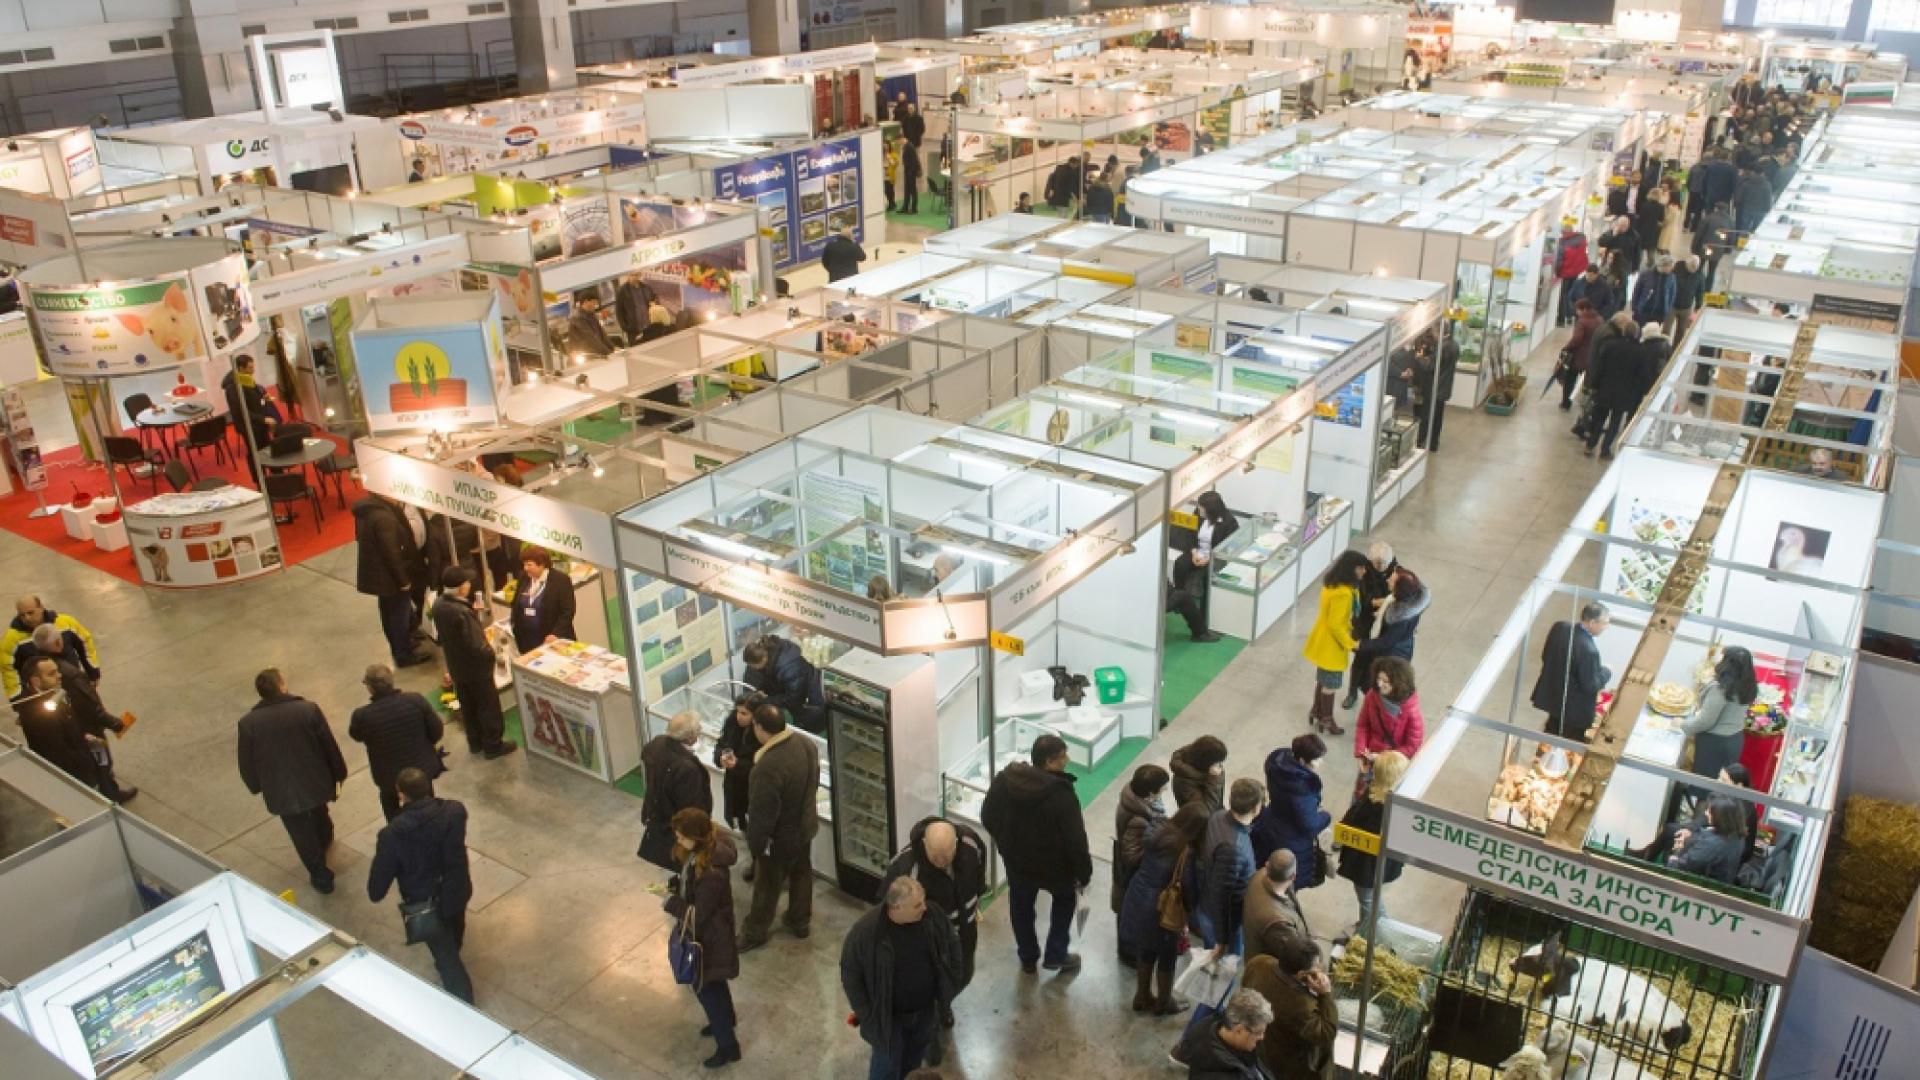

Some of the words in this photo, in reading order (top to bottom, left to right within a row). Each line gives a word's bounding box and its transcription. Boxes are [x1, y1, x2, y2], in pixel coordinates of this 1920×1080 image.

[630, 247, 662, 265] АГРО
[37, 292, 126, 309] СВИНЕВЪСТВО
[453, 479, 498, 502] ИПАЗР
[530, 519, 584, 551] СОФИЯ
[794, 601, 825, 620] Троян
[1411, 814, 1588, 883] ЗЕМЕДЕЛСКИ
[1595, 864, 1745, 933] ИНСТИТУТ
[1477, 859, 1560, 899] СТАРА
[1568, 887, 1675, 936] ЗАГОРА
